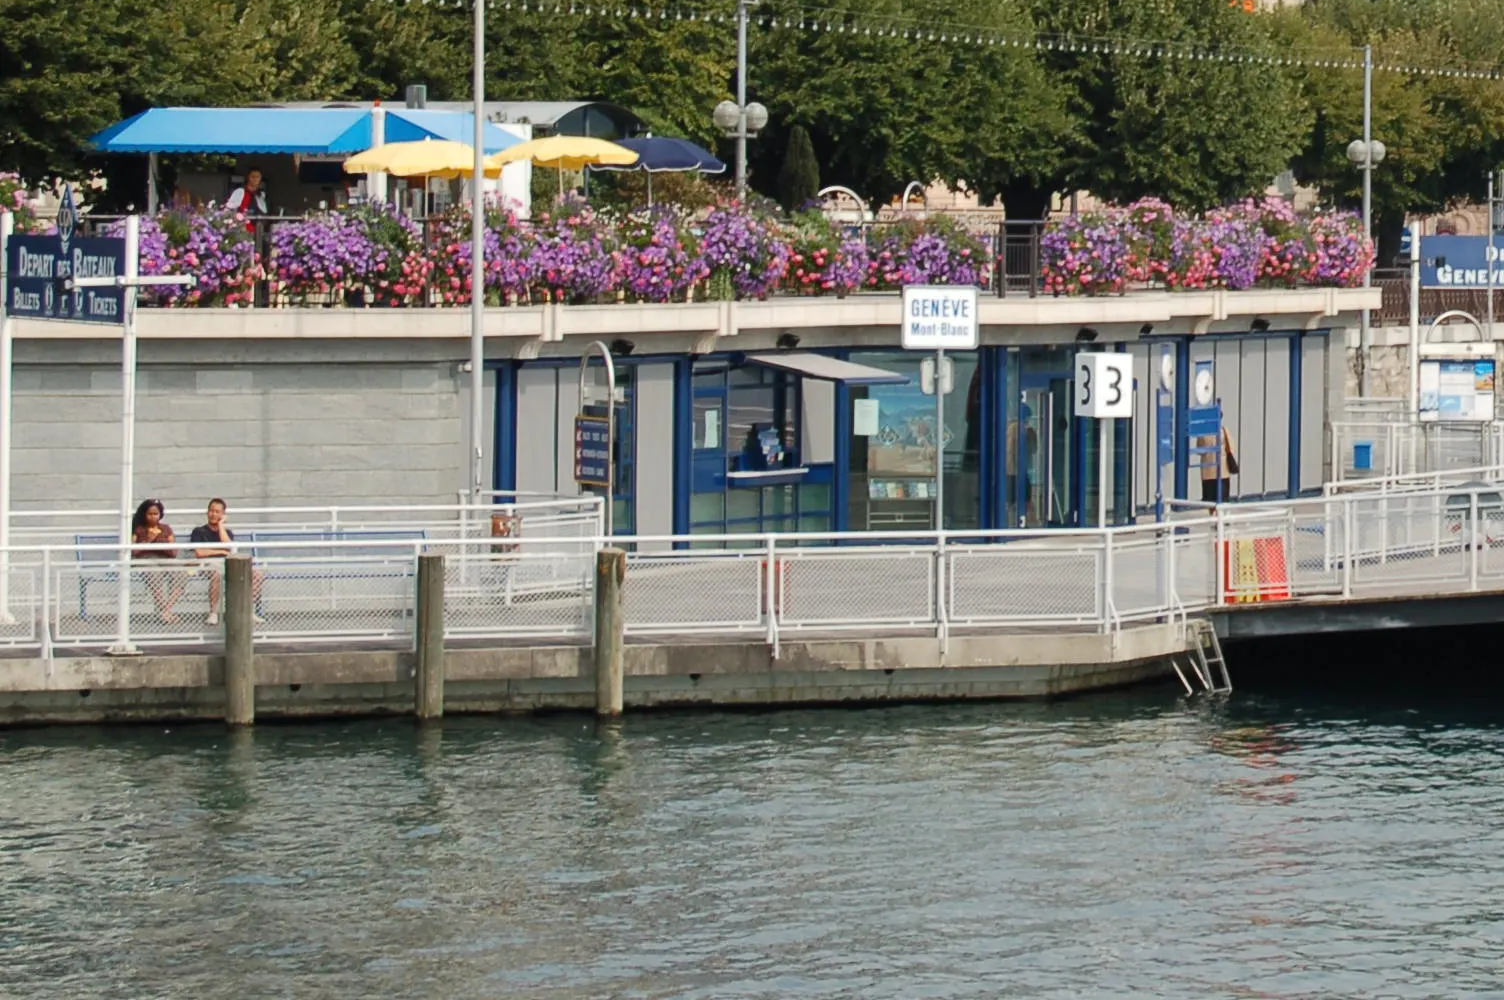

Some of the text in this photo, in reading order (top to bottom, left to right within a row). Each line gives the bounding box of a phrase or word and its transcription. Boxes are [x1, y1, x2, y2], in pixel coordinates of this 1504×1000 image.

[13, 287, 117, 315] BILLETS TICKETS
[911, 322, 969, 336] Mont-Blanc
[1106, 366, 1122, 406] 3
